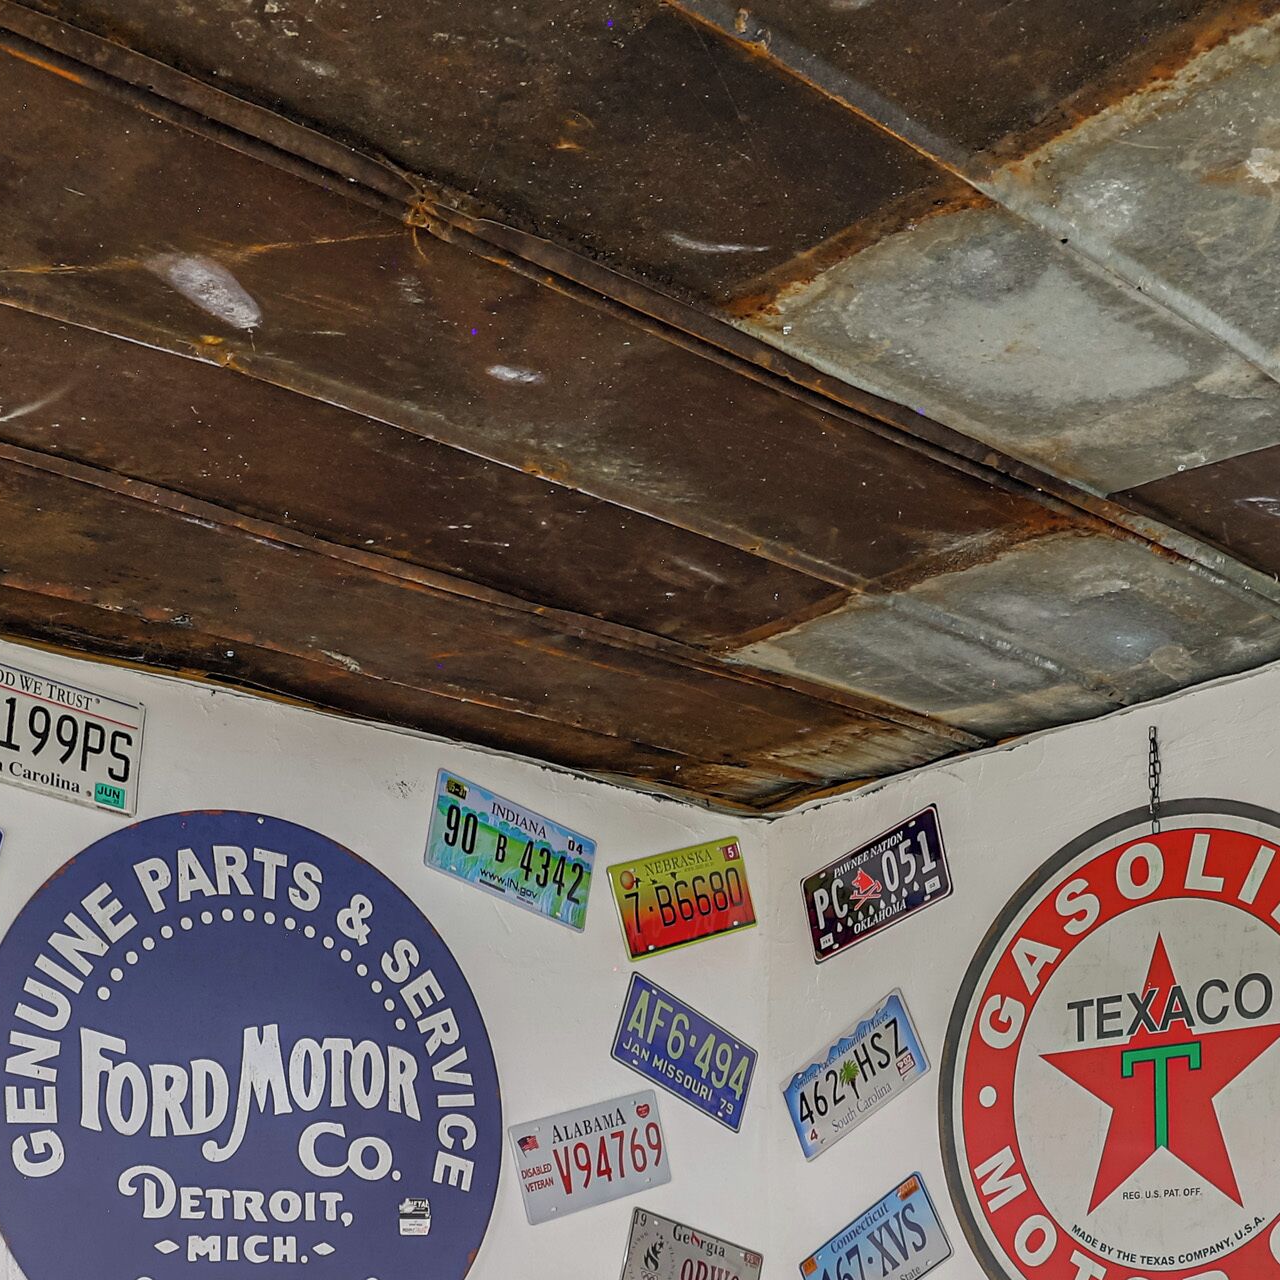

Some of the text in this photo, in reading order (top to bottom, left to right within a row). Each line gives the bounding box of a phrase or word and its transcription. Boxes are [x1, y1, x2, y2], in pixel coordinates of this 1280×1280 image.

[20, 673, 43, 696] WE
[46, 683, 93, 711] TRUST
[8, 761, 82, 795] Carolina
[97, 785, 120, 800] JUN
[491, 801, 548, 840] INDIANA
[444, 804, 586, 906] 90 B 4342
[644, 848, 713, 877] NEBRASKA
[833, 830, 904, 879] PAWNEE NATION
[813, 830, 937, 931] PC 051
[853, 898, 907, 935] OKLAHOMA
[3, 844, 479, 1193] GENUINE PARTS & SERVICE
[1067, 971, 1275, 1044] TEXACO
[622, 1036, 714, 1100] JAN MISSOURI
[799, 1016, 909, 1125] 462 HSZ
[831, 1082, 893, 1133] South Carolina
[1120, 1040, 1202, 1150] T
[551, 1107, 628, 1145] ALABAMA
[521, 1162, 552, 1180] DISABLED
[552, 1121, 663, 1197] V94769
[117, 1164, 355, 1228] DETROIT,
[525, 1176, 555, 1194] VETERAN
[1122, 1188, 1181, 1200] REG. U.S. PAT.
[672, 1223, 726, 1258] Georgia
[830, 1201, 890, 1254] Connecticut
[1071, 1215, 1266, 1266] MADE BY THE TEXAS COMPANY, U.S.A.
